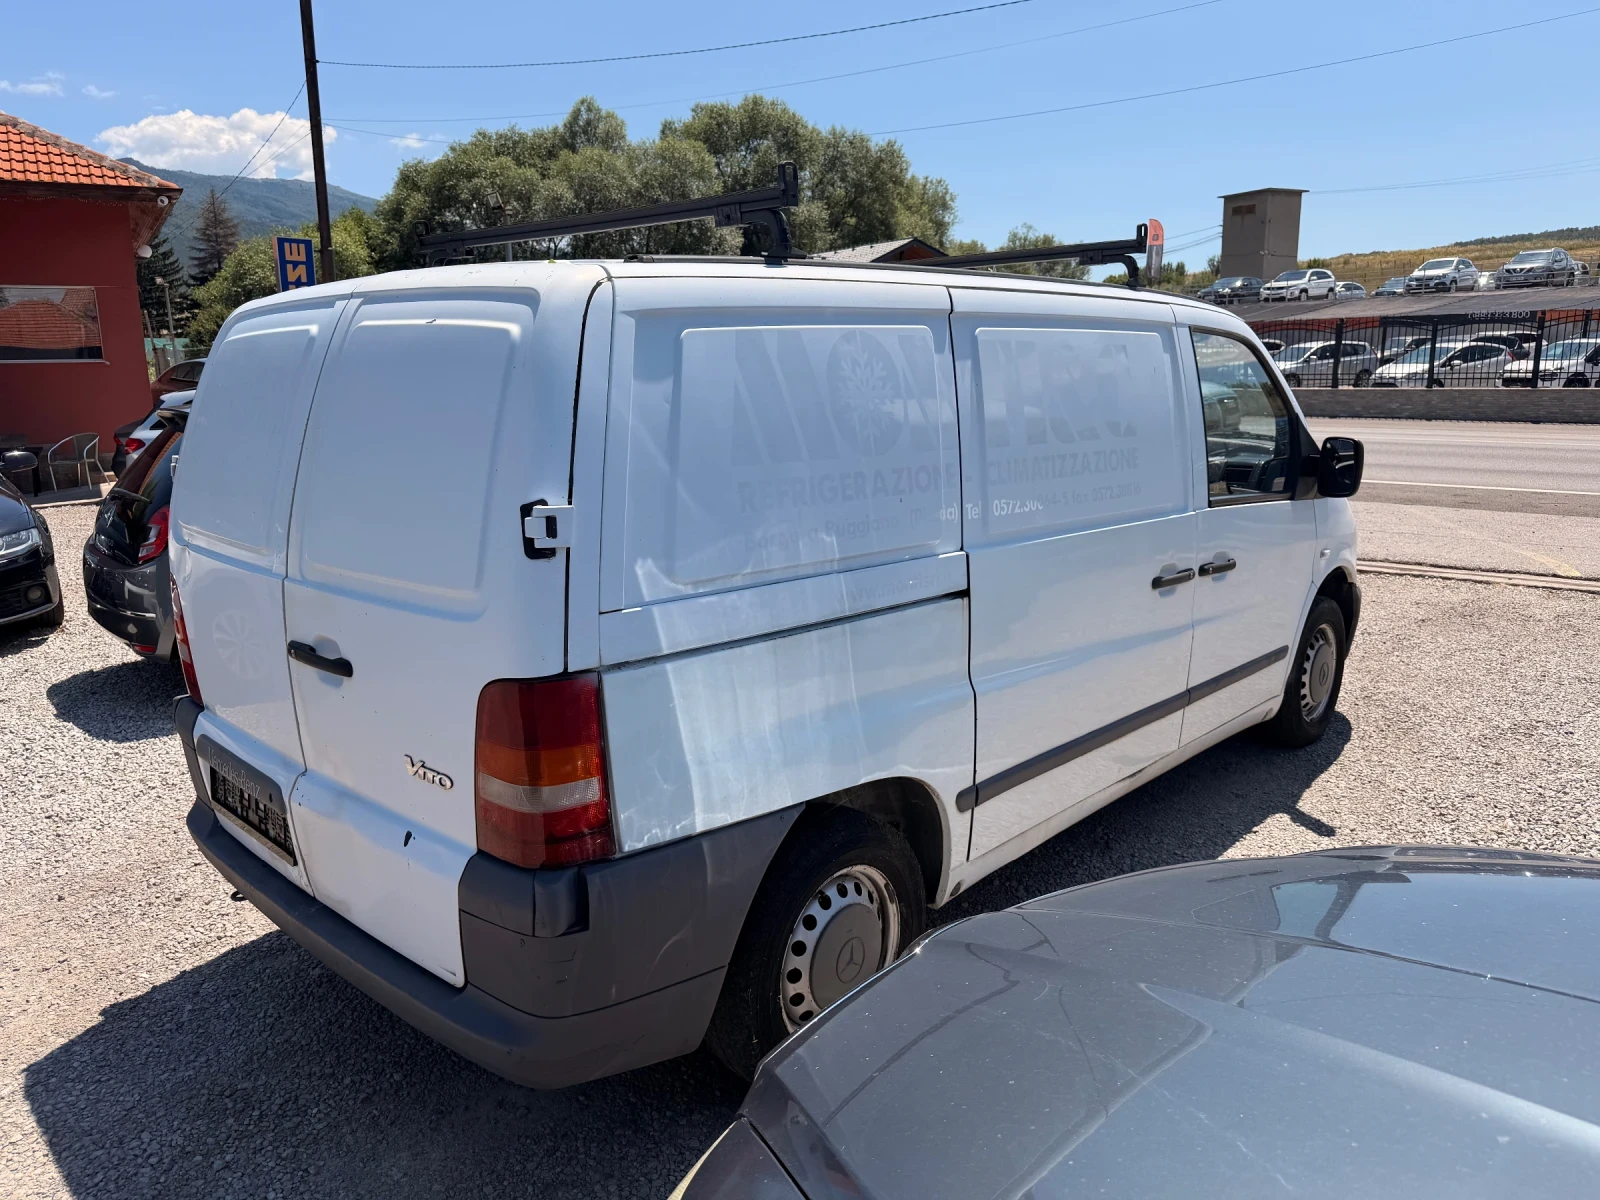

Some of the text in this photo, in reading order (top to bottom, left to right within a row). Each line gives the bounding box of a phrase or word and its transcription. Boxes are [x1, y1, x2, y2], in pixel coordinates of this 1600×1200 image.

[284, 242, 309, 290] ШИ
[737, 463, 956, 513] REFRIGERAZIONE
[987, 447, 1140, 486] CLIMATIZZAZIONE
